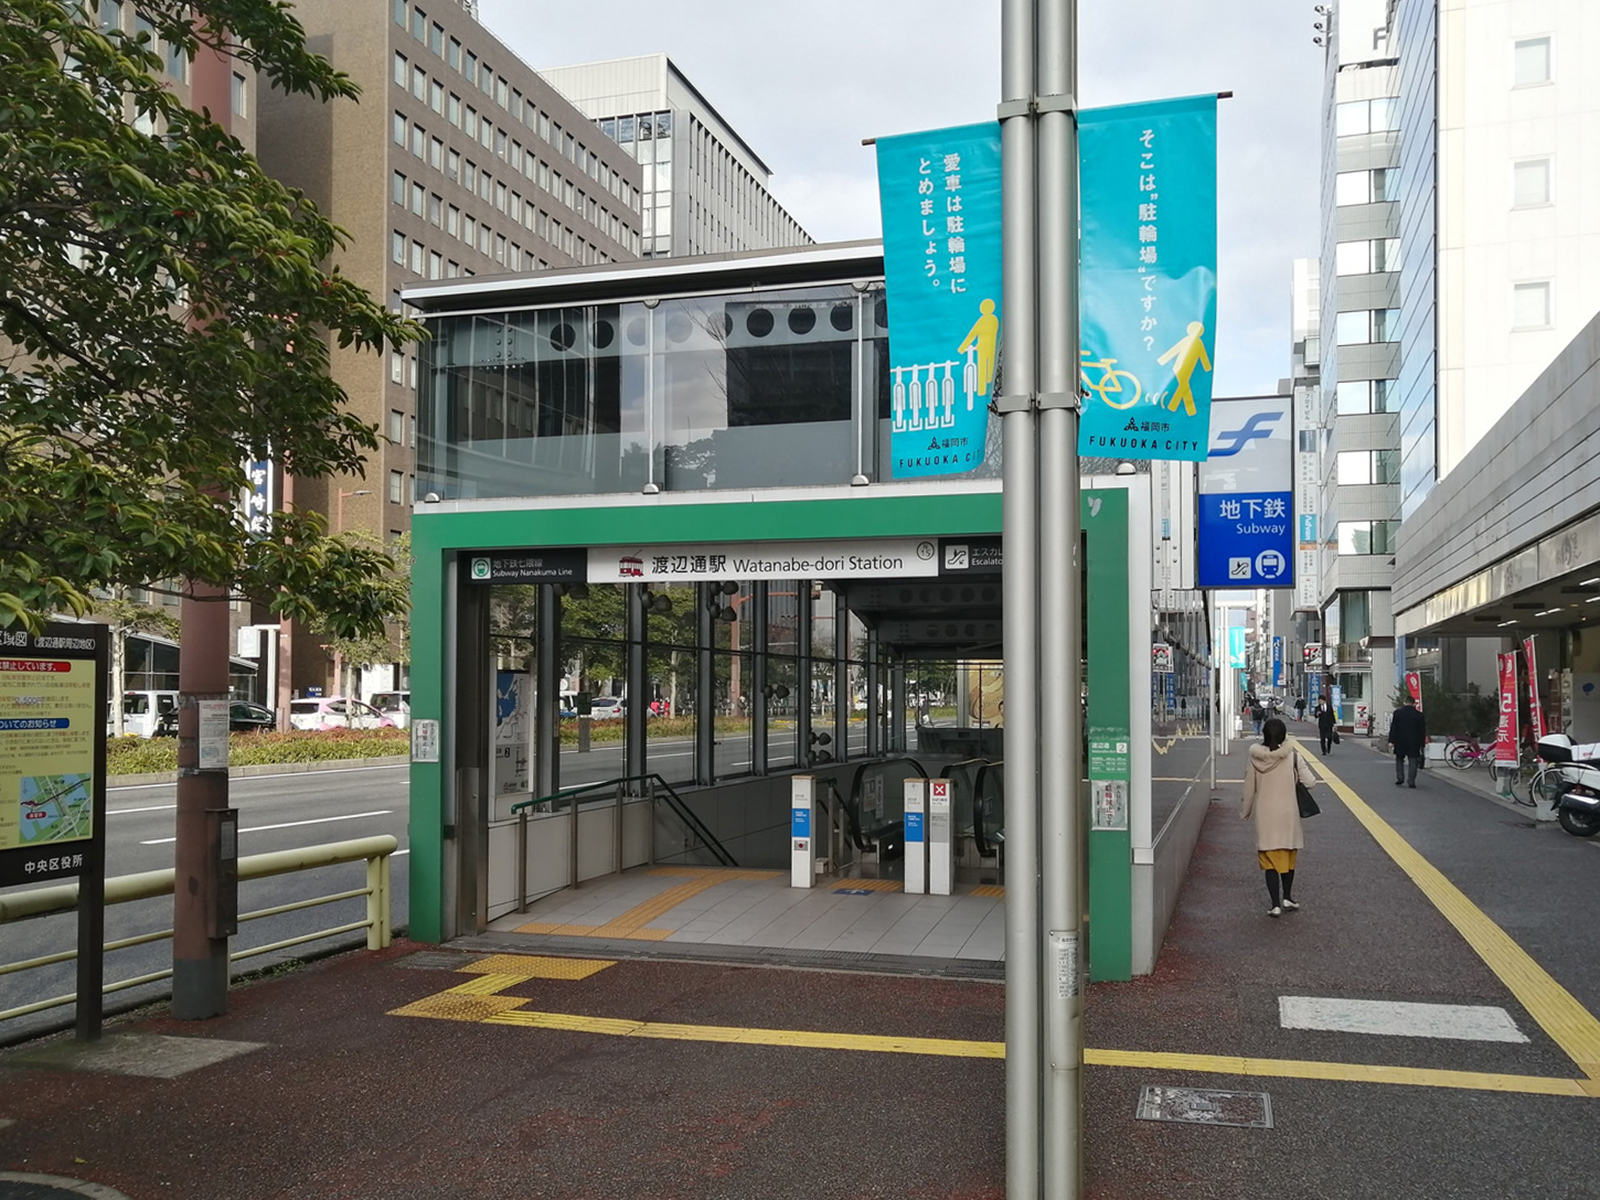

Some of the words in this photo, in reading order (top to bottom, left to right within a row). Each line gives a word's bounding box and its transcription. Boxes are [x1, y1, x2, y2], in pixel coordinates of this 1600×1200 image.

[918, 157, 940, 288] とめましょう。
[943, 151, 966, 294] 愛車は駐輪場に
[1140, 422, 1170, 432] 福岡市
[942, 437, 968, 448] 福岡市
[1089, 436, 1157, 449] FUKUOKA
[1165, 440, 1198, 451] CITY
[900, 454, 959, 468] FUKUOKA
[1219, 498, 1286, 520] 地下鉄
[1236, 523, 1286, 536] Subway
[492, 558, 543, 568] 地下鉄七隈線
[651, 555, 727, 574] 渡辺通駅
[733, 556, 845, 573] Watanabe-dori
[849, 555, 903, 571] Station
[971, 557, 1003, 566] Escalato
[492, 568, 519, 578] Subway
[520, 568, 557, 577] Nanakuma
[558, 567, 573, 576] Line
[0, 630, 28, 647] 域図
[0, 661, 57, 671] 禁止しています。
[24, 853, 83, 874] 中央区役所
